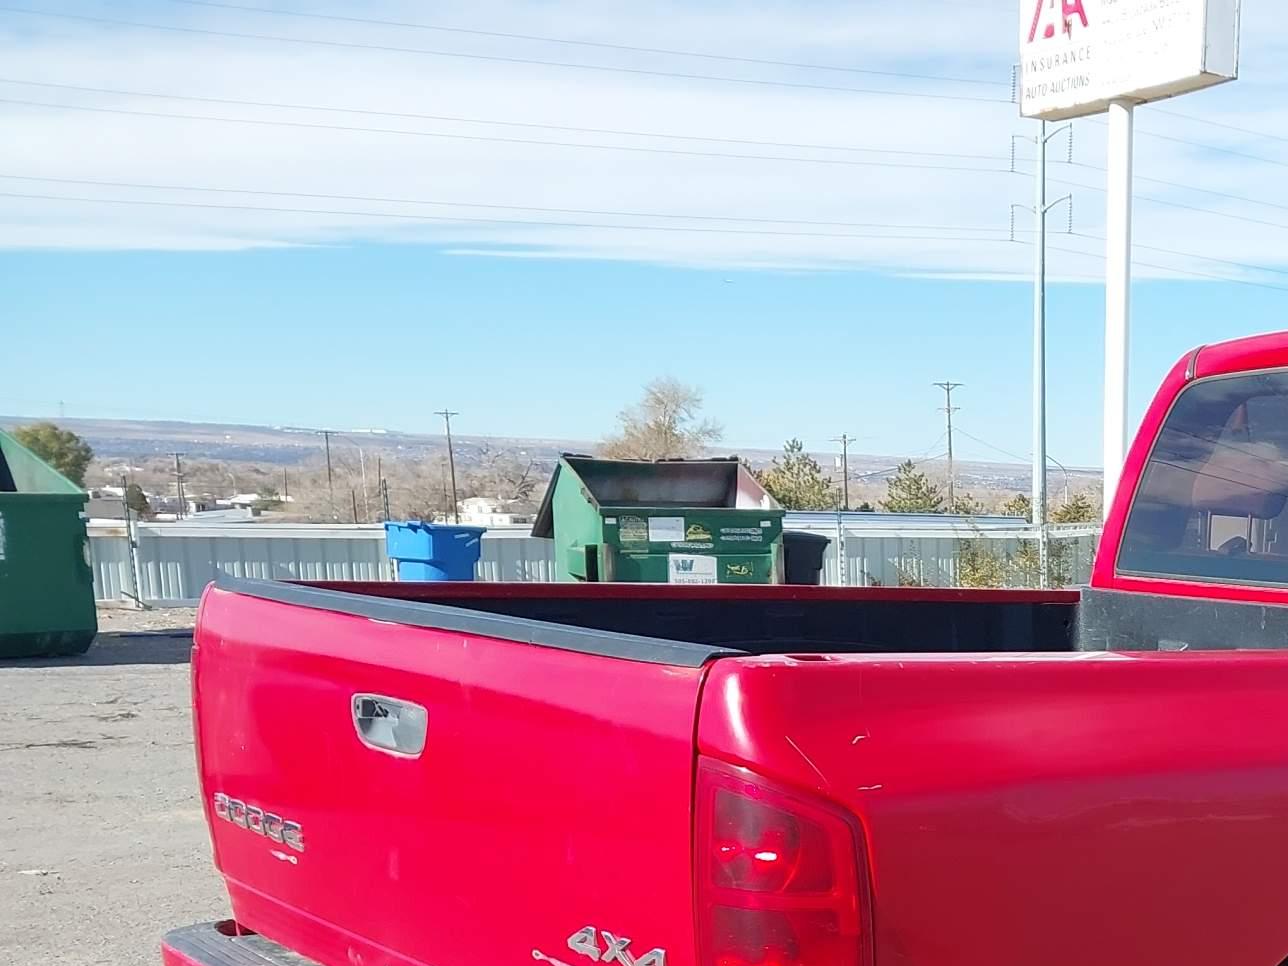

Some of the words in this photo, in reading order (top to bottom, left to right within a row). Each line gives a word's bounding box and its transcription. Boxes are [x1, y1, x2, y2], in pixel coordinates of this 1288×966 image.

[1025, 45, 1091, 73] INSURANCE
[1025, 83, 1048, 100] AUTO
[1050, 74, 1090, 94] AUCTIONS
[214, 792, 304, 852] DODGE
